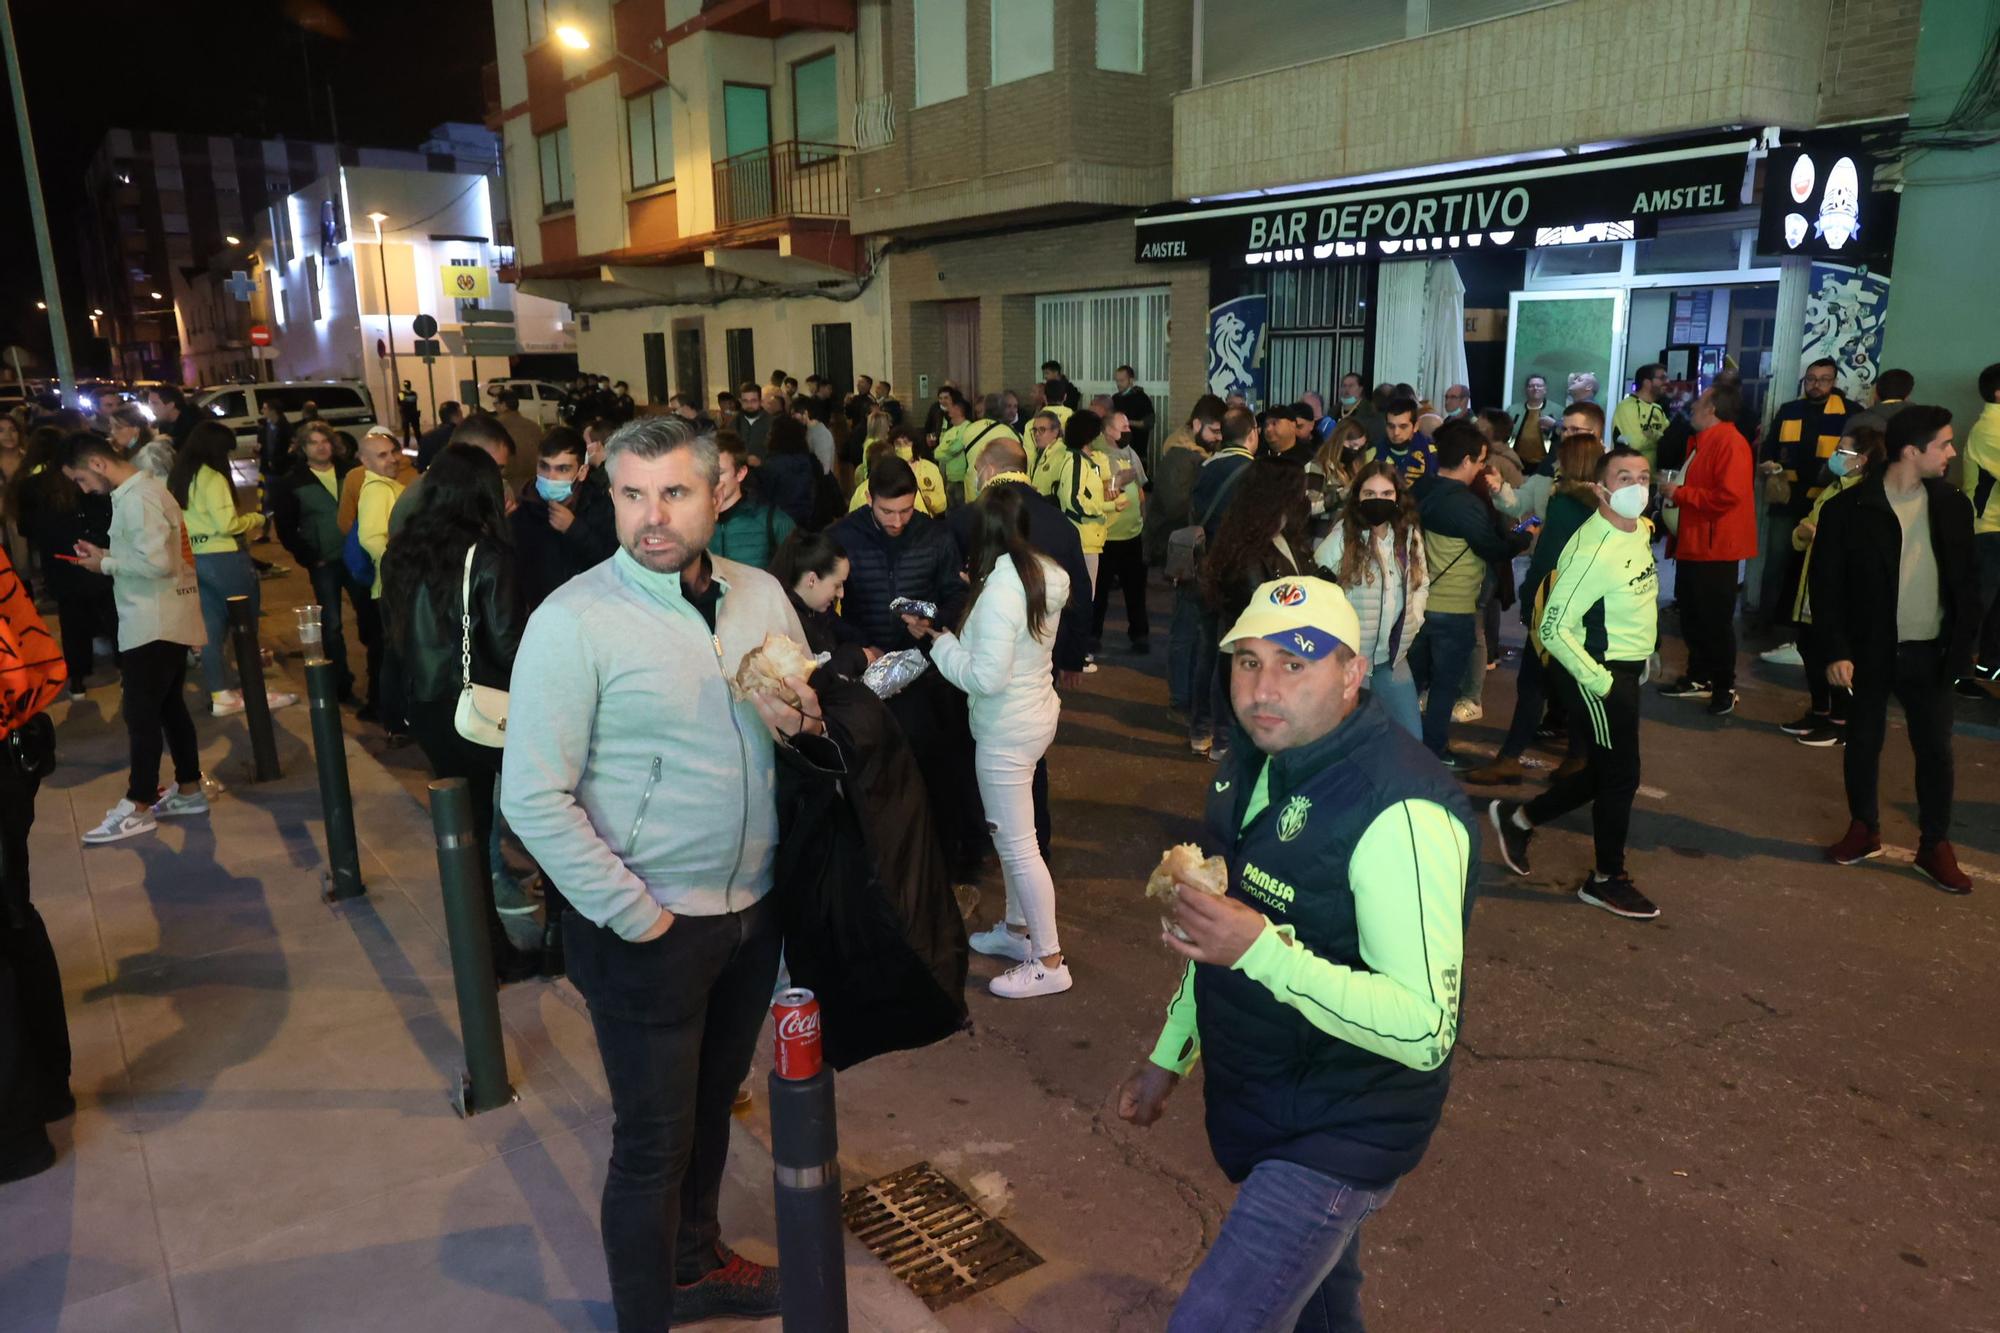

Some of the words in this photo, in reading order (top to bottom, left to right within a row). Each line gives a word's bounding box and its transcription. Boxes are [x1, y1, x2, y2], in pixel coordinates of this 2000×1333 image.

[1631, 183, 1725, 214] AMSTEL
[1248, 211, 1308, 250] BAR
[1317, 187, 1530, 240] DEPORTIVO
[1141, 240, 1188, 258] AMSTEL
[1242, 862, 1295, 903] PAMESA
